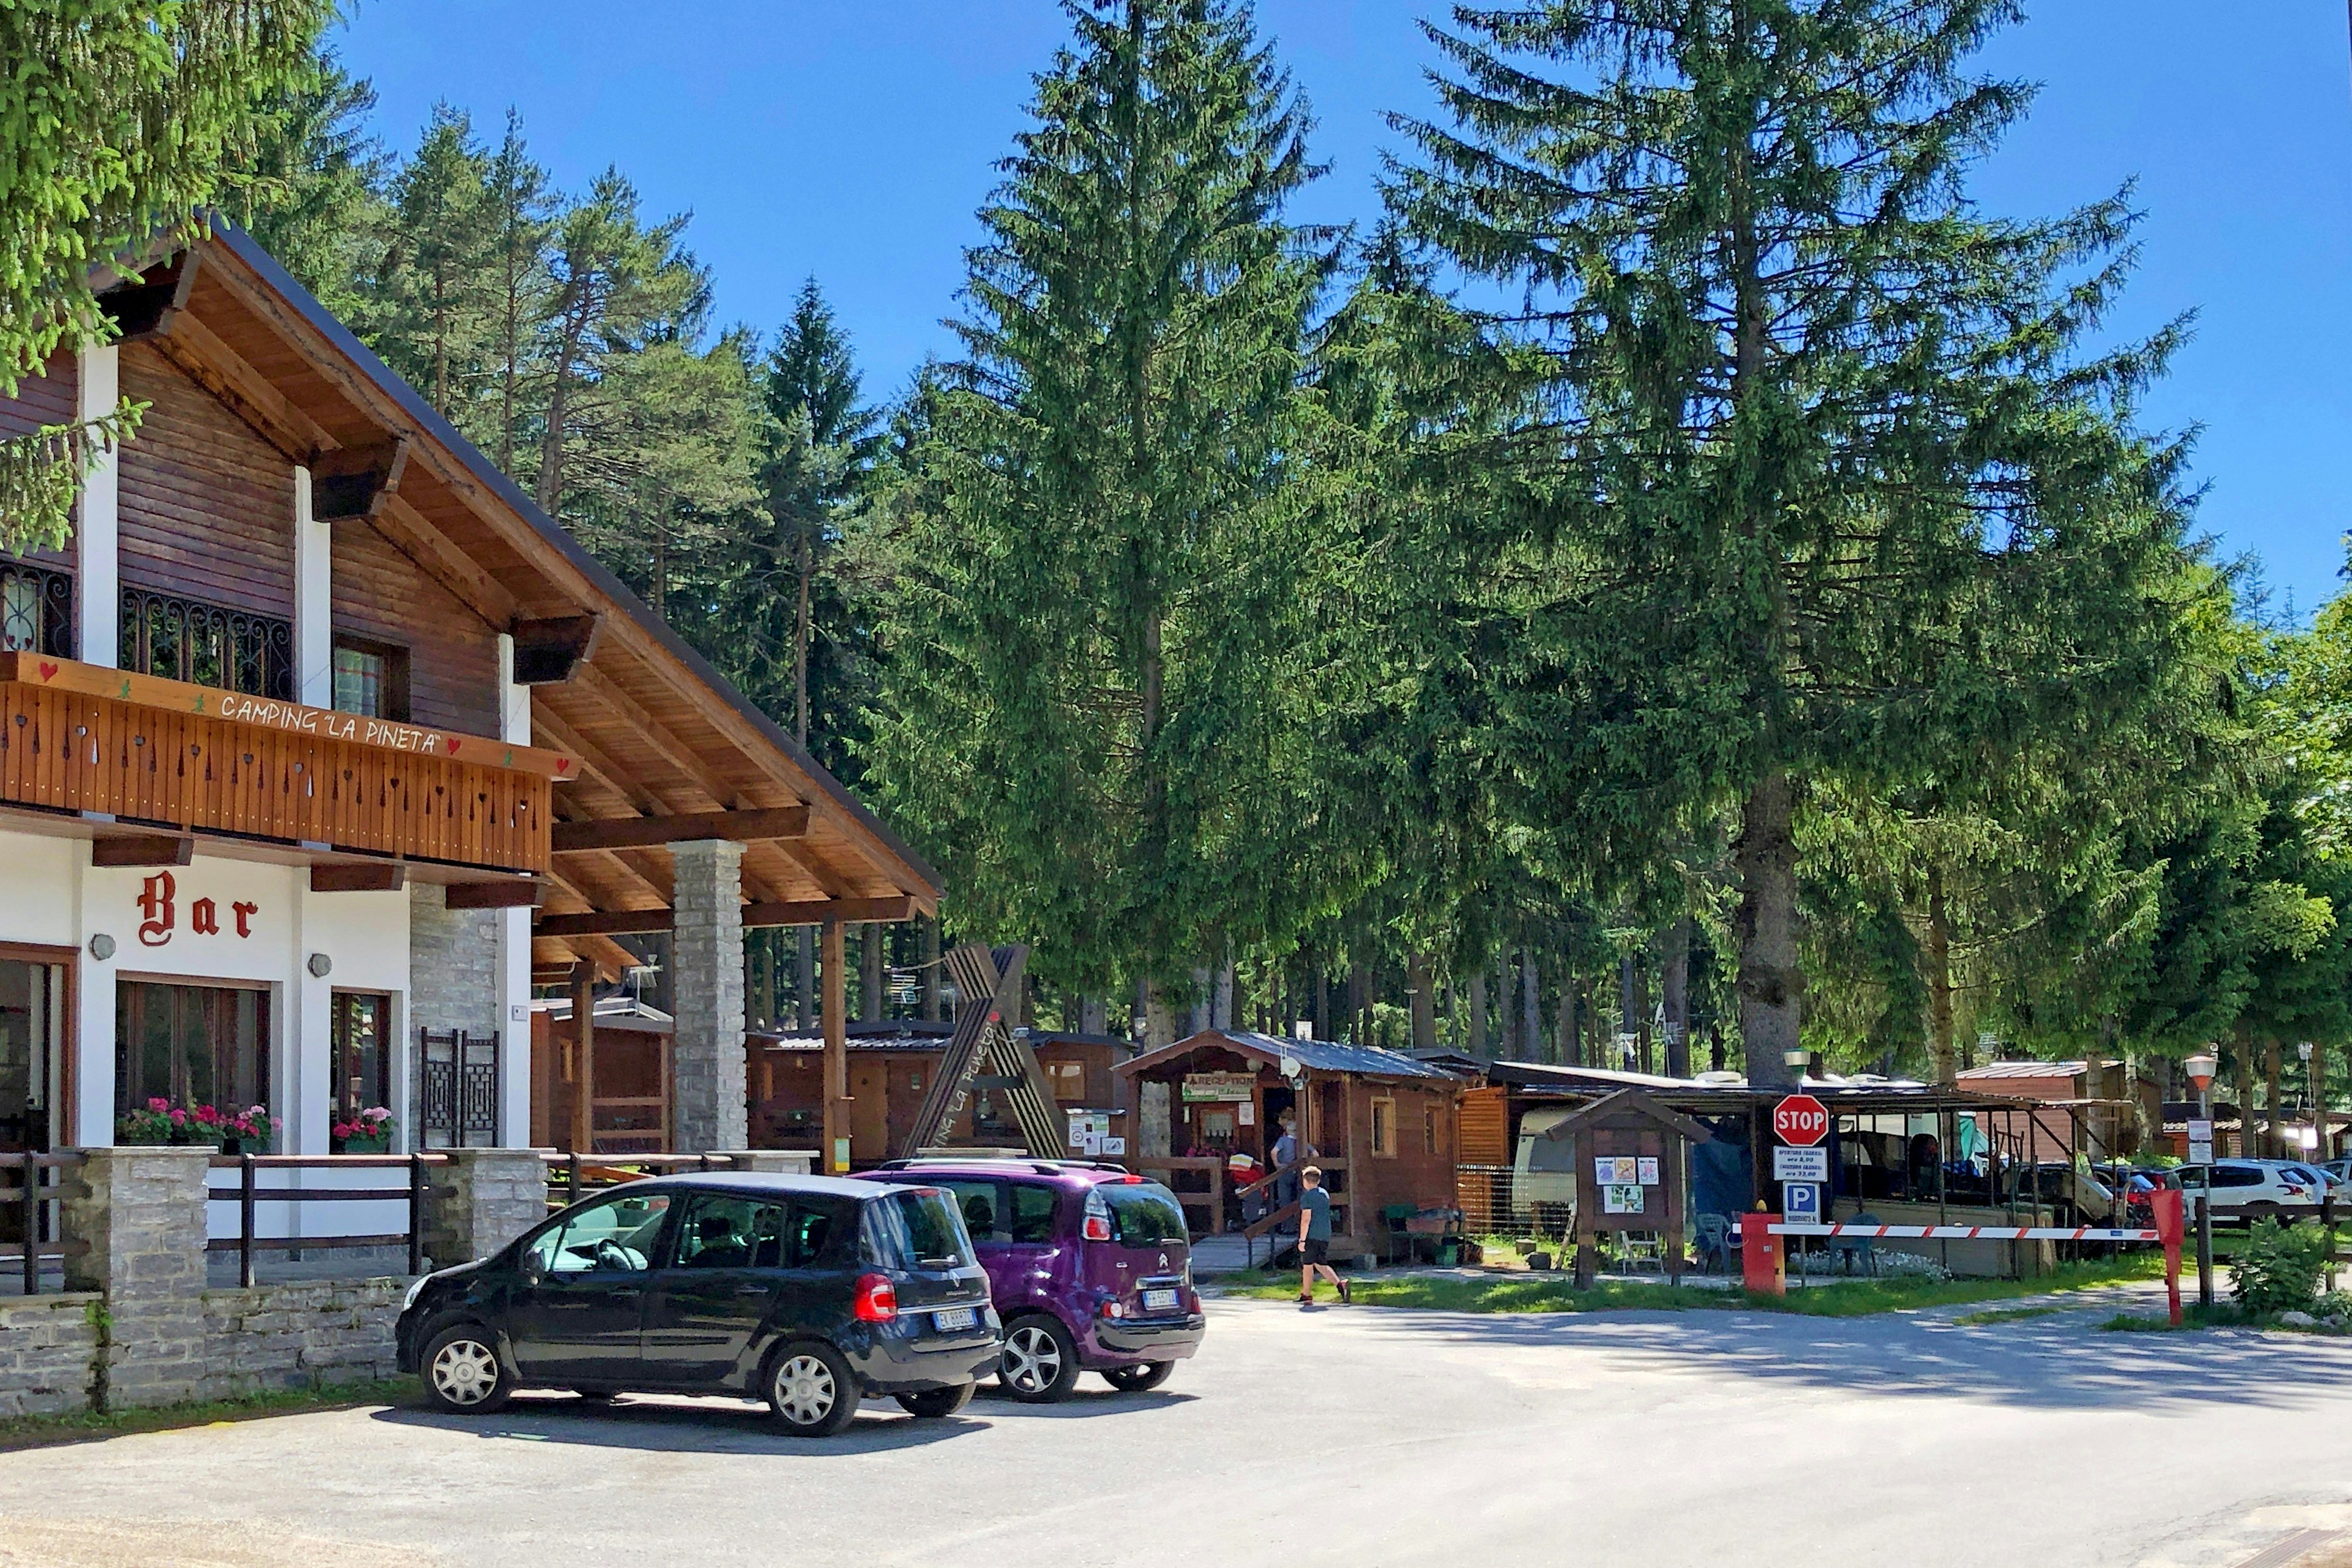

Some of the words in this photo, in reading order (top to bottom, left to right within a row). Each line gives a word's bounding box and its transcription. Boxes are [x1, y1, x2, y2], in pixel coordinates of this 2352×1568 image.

[222, 696, 318, 734] CAMPING
[137, 870, 258, 947] Bar
[1778, 1111, 1824, 1130] STOP
[1793, 1188, 1810, 1209] P
